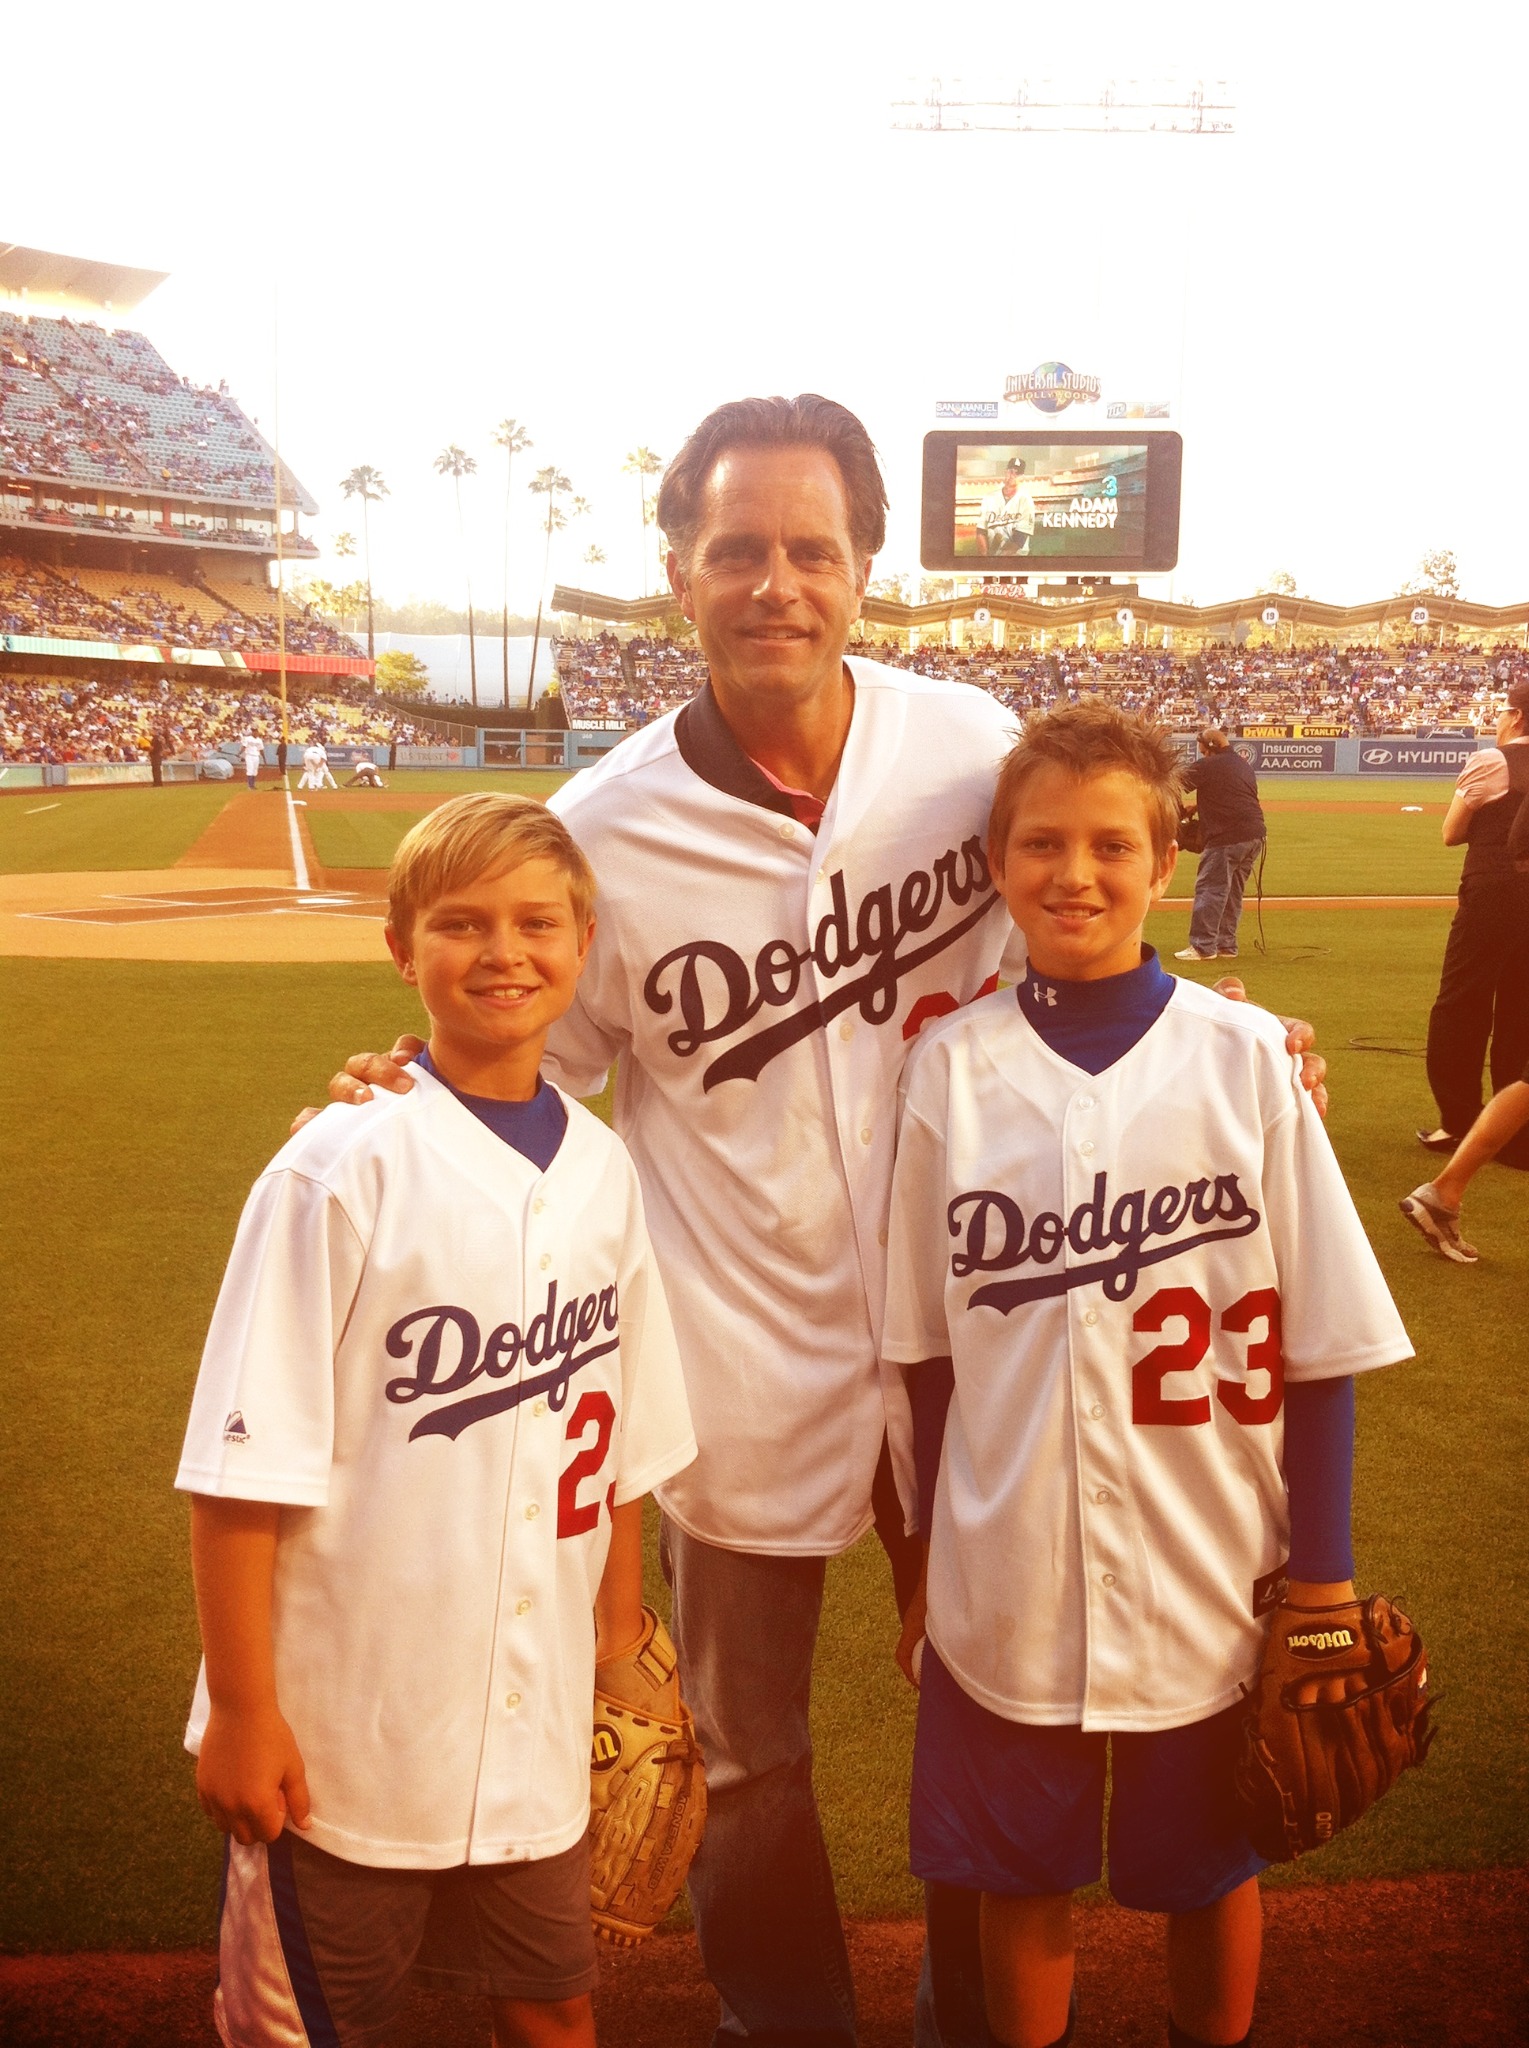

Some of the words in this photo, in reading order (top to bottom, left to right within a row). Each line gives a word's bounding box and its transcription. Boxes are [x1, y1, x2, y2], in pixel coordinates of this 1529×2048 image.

[1005, 373, 1059, 392] UNIVERSAL
[1061, 372, 1102, 394] STUDIOS
[1017, 391, 1089, 400] HOLLYWOOD
[936, 402, 955, 412] SAN
[961, 402, 997, 412] MANUEL
[1101, 475, 1118, 497] 3
[1069, 497, 1118, 513] ADAM
[1042, 512, 1118, 528] KENNEDY
[979, 612, 985, 621] 2
[1121, 612, 1127, 621] 4
[1266, 611, 1275, 621] 19
[1414, 611, 1425, 620] 20
[572, 719, 604, 730] MUSCLE
[605, 719, 628, 731] MILK
[1304, 728, 1341, 736] STANLEY
[1262, 743, 1323, 754] Insurance
[417, 752, 444, 760] TRUST
[1398, 751, 1470, 763] HYUNDA
[1261, 759, 1322, 769] AAA.com
[948, 1171, 1260, 1302] Dodgers
[385, 1279, 618, 1413] Dodger
[1132, 1287, 1285, 1426] 23
[1286, 1629, 1354, 1652] Wilson
